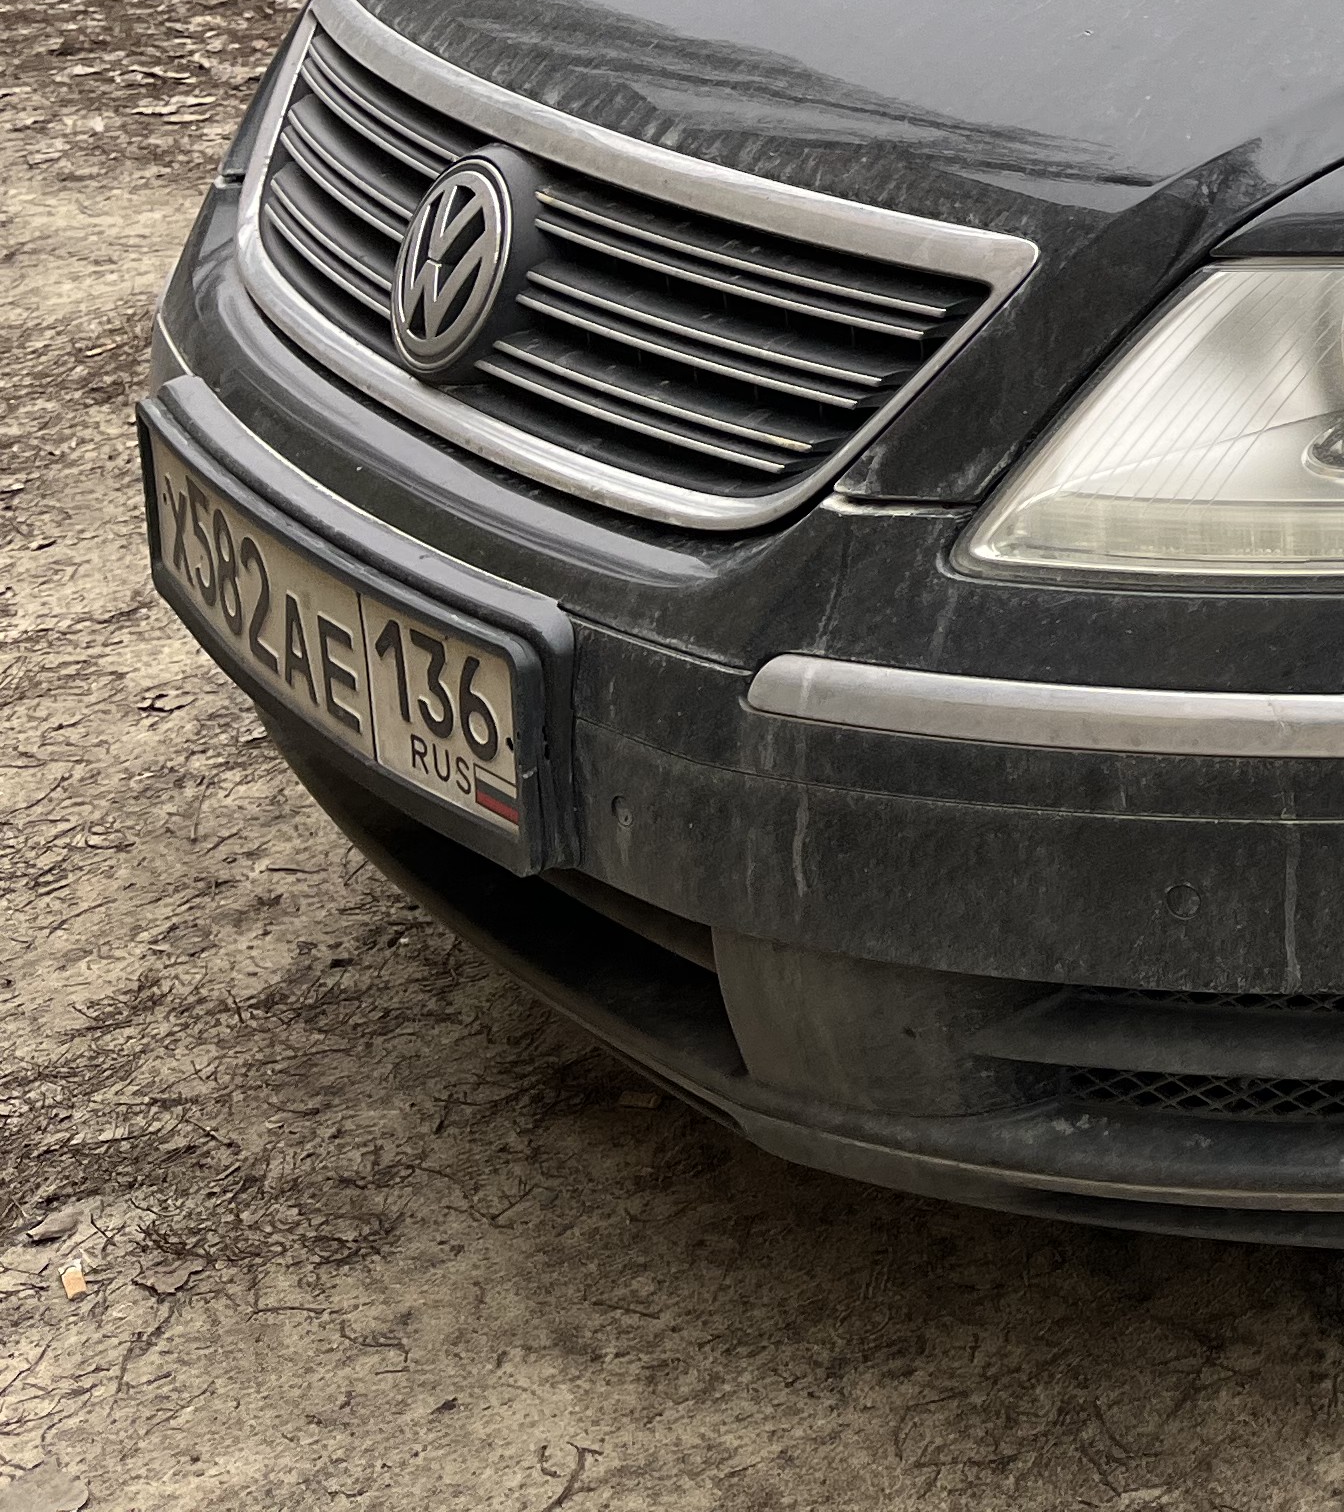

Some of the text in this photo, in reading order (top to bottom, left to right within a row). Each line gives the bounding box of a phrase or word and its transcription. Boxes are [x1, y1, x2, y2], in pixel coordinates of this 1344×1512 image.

[164, 472, 499, 761] Х582АЕ 136
[410, 733, 473, 795] RUS
